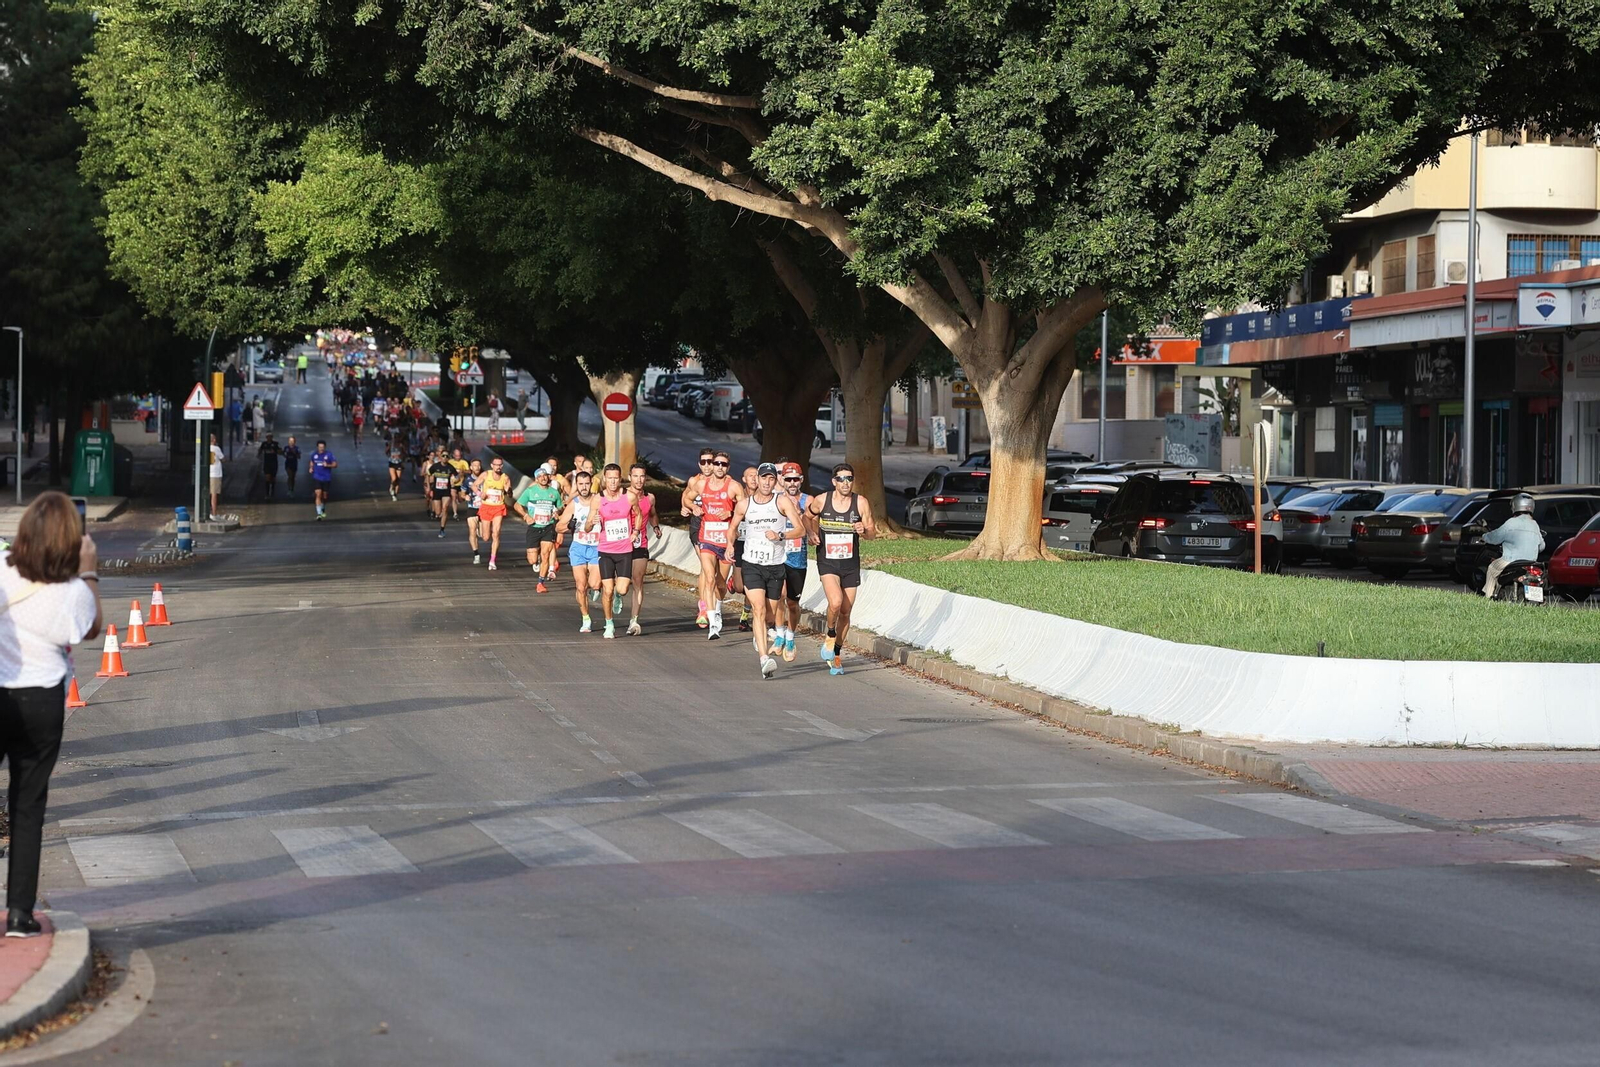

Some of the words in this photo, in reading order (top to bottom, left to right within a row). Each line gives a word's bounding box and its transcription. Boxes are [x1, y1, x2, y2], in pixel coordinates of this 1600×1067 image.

[607, 527, 628, 536] 11948
[709, 532, 725, 540] 154
[1187, 537, 1204, 545] 4830
[1207, 537, 1220, 546] JTB
[830, 545, 848, 554] 229
[750, 549, 770, 560] 1131
